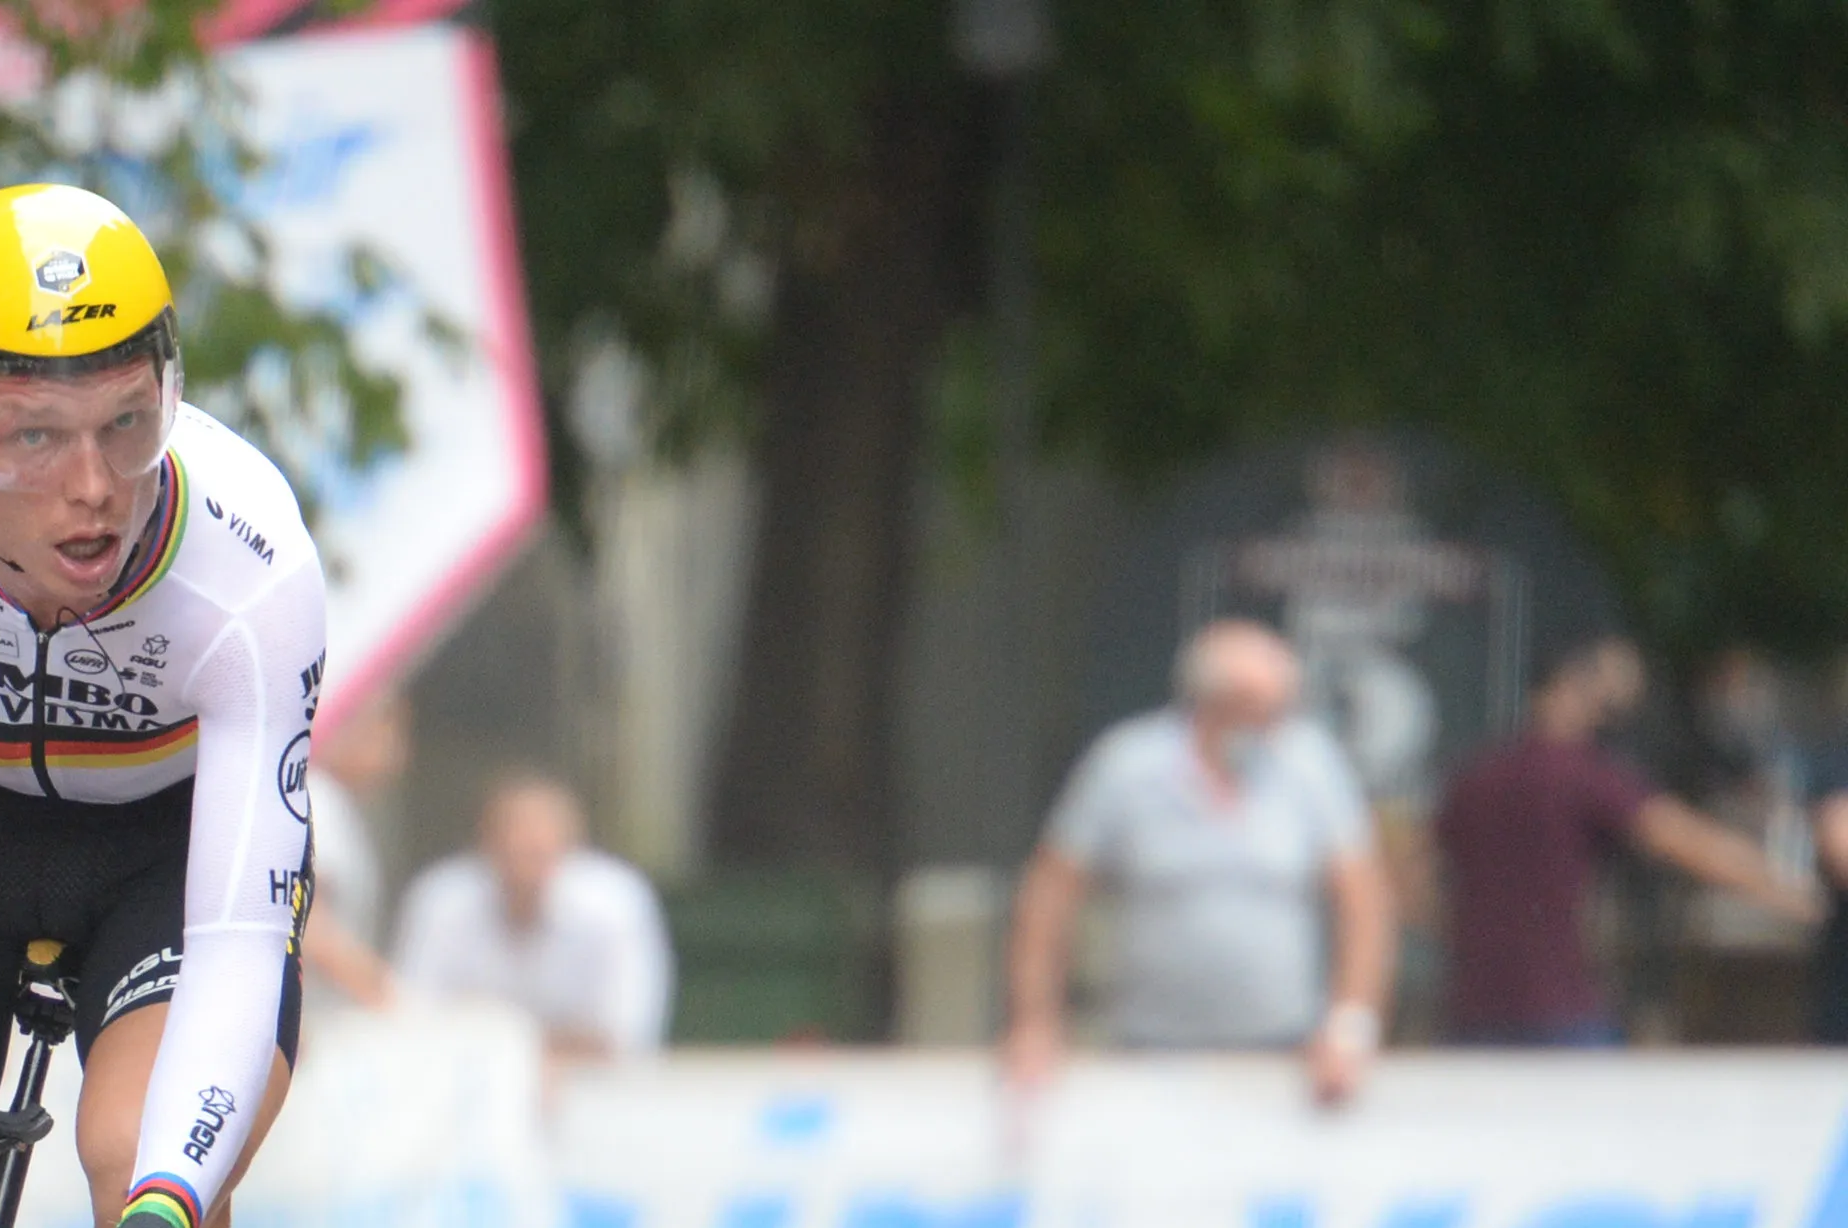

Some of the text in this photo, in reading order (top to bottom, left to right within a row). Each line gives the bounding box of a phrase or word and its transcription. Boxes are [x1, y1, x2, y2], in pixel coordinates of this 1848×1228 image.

[26, 303, 117, 332] LAZER
[229, 512, 274, 566] VISMA
[183, 1107, 225, 1166] AGU
